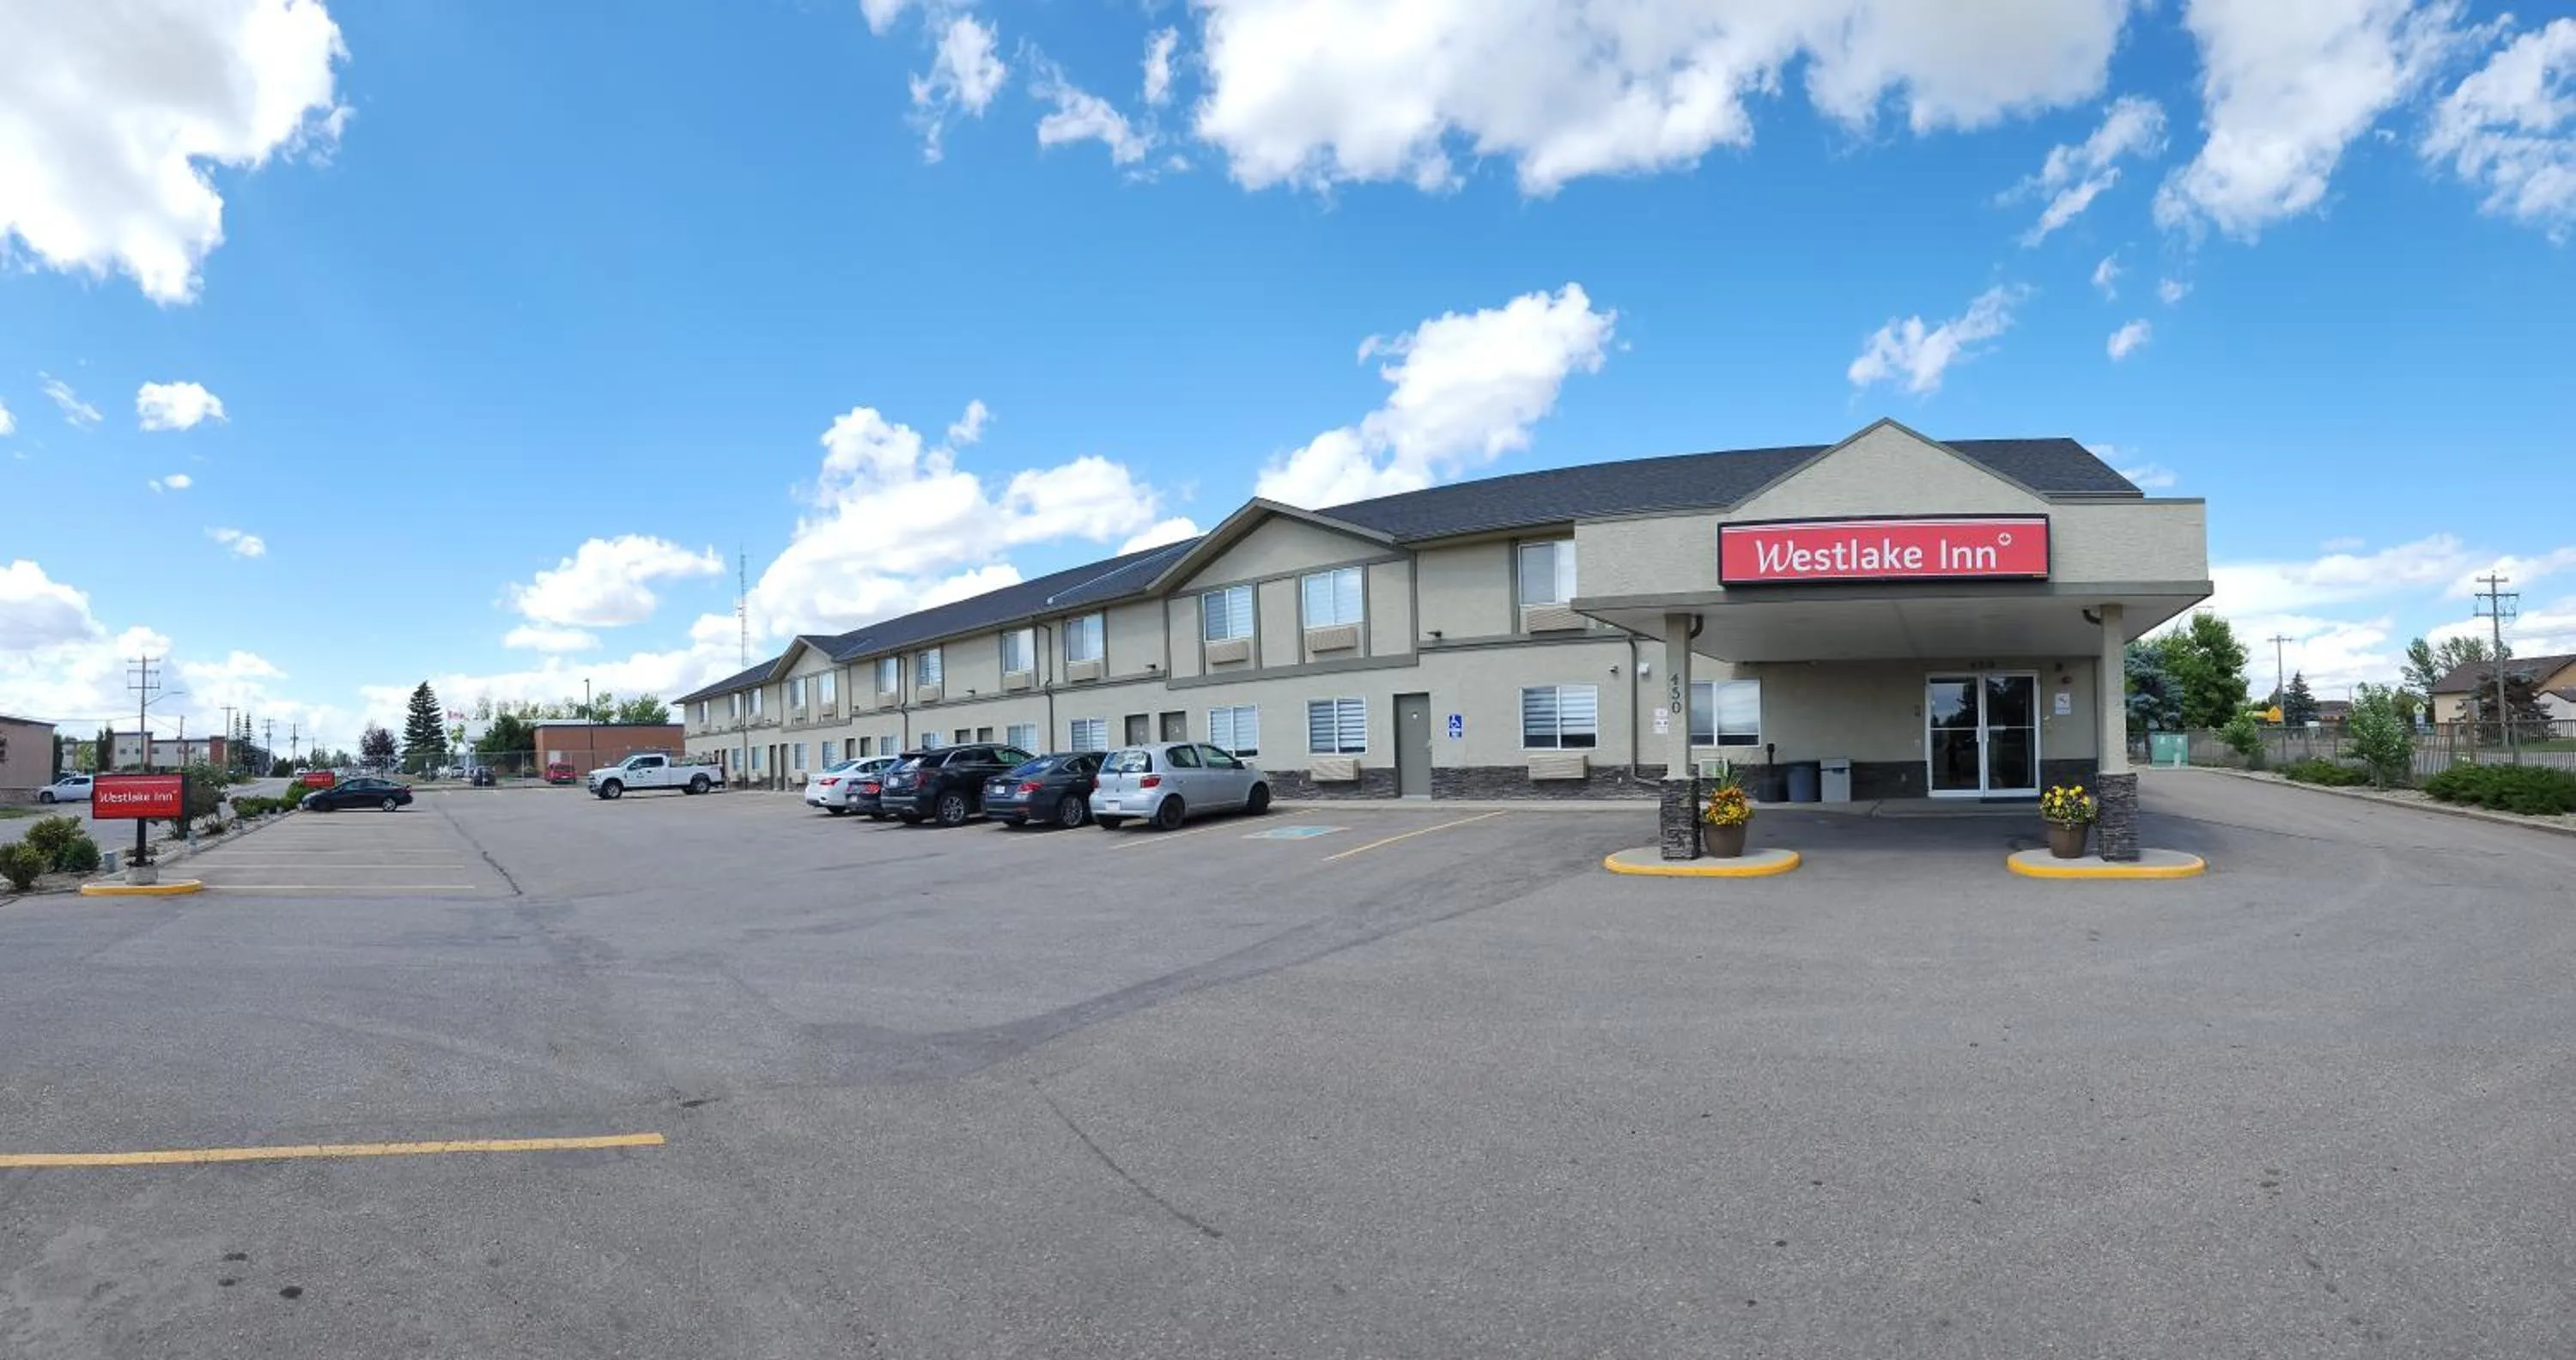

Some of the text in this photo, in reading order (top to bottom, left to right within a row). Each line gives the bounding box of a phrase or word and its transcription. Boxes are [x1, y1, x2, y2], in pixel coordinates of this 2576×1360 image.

[1754, 538, 1997, 574] Westlake Inn
[1670, 673, 1681, 714] 450
[99, 791, 173, 803] Westlake Inn
